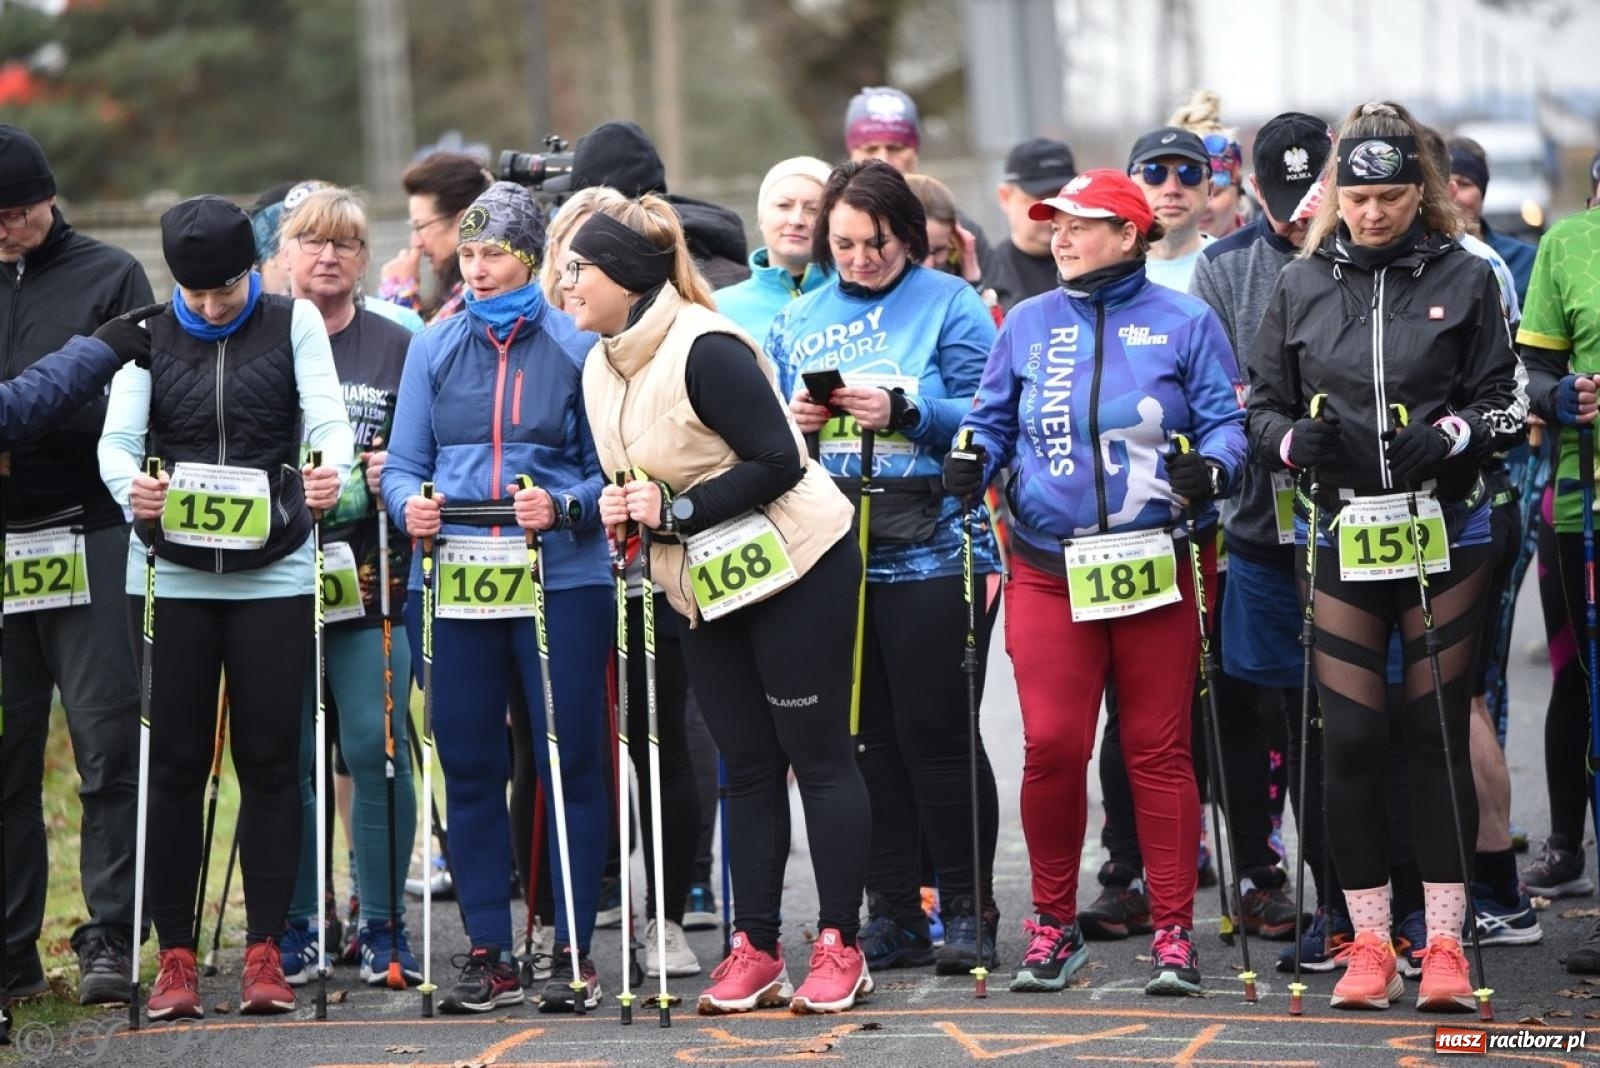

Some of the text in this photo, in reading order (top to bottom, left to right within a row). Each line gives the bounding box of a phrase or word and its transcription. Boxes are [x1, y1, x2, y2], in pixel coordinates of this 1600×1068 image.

[1041, 325, 1078, 476] RUNNERS
[1025, 416, 1044, 457] TEAM
[180, 494, 254, 533] 157
[4, 557, 71, 595] 152
[452, 567, 525, 603] 167
[697, 543, 771, 601] 168
[1086, 560, 1161, 603] 181
[644, 586, 654, 645] FIZAN
